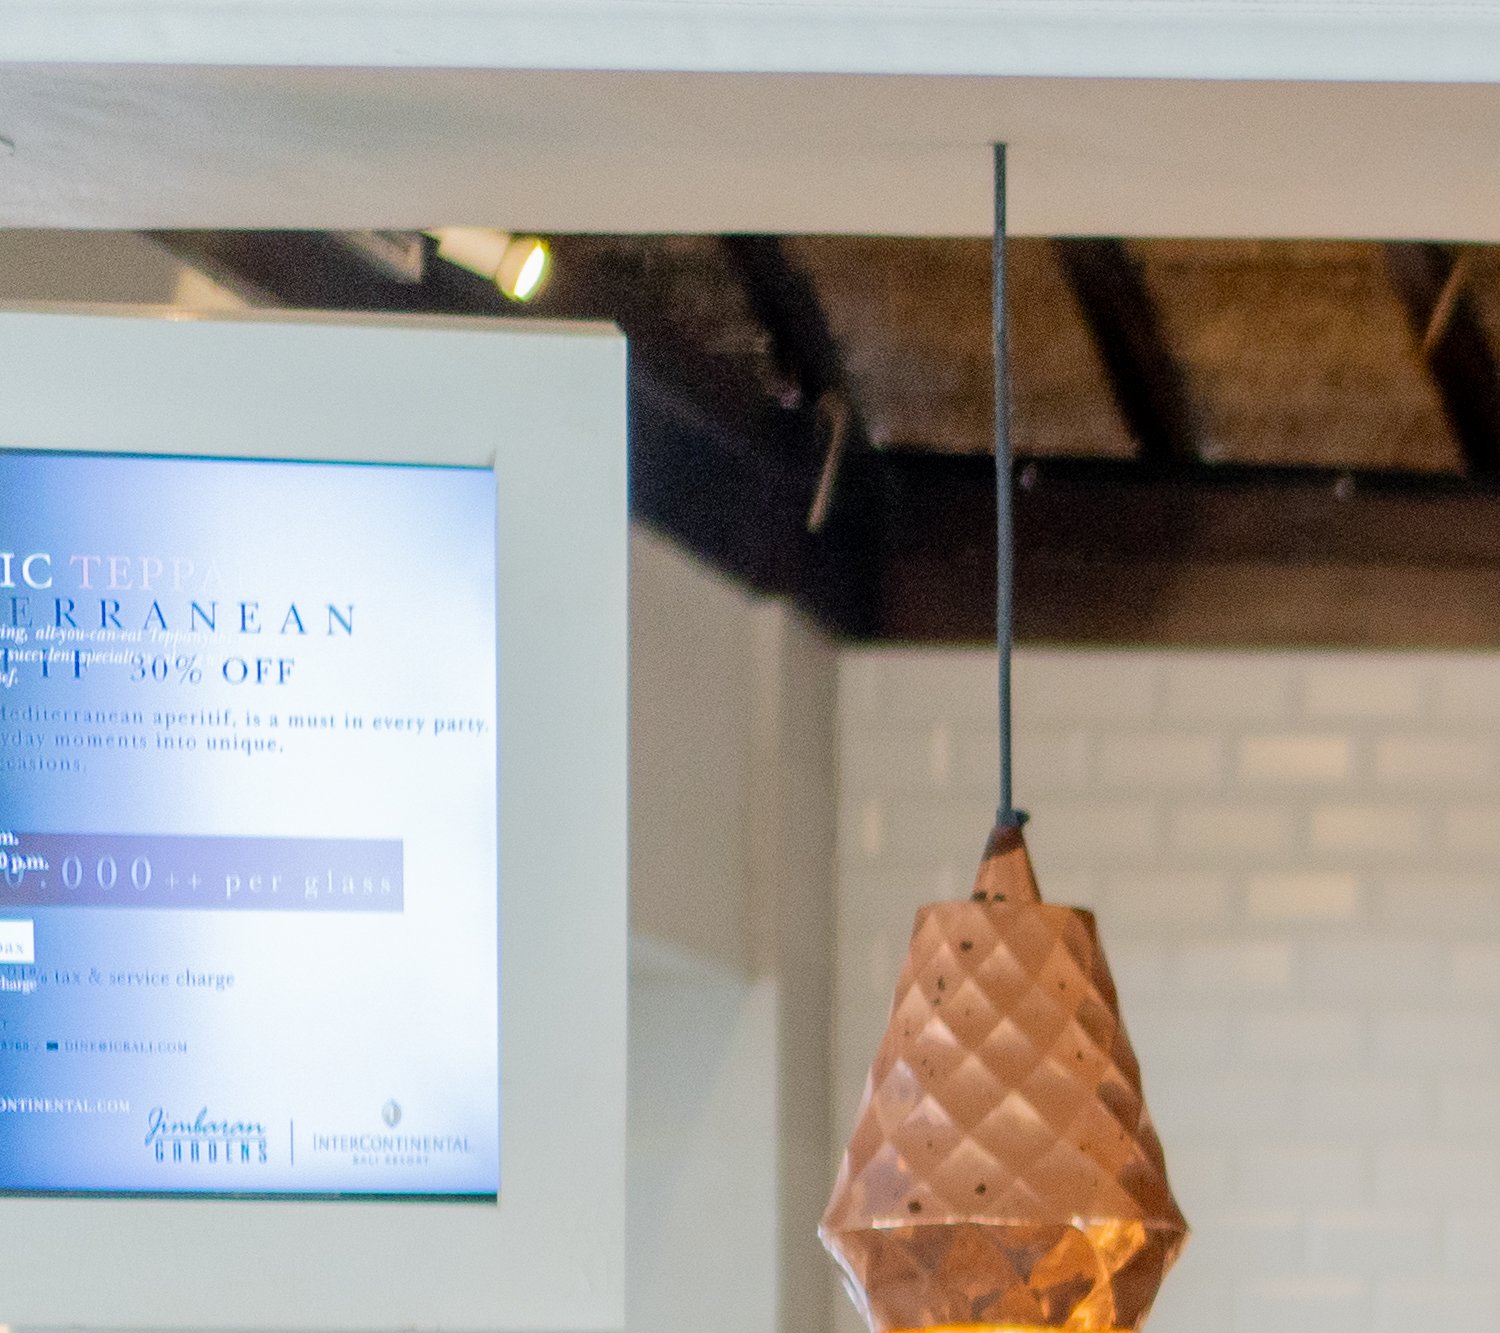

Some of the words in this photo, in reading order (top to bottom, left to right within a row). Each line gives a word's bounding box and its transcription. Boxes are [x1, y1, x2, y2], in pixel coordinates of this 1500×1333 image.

[222, 656, 295, 686] OFF
[245, 709, 261, 728] is
[269, 711, 279, 728] a
[288, 711, 336, 729] must
[344, 709, 363, 730] in
[372, 713, 425, 735] every
[55, 733, 148, 751] moments
[156, 734, 197, 752] into
[226, 873, 283, 899] per
[305, 868, 392, 900] glass
[109, 970, 169, 986] service
[176, 968, 236, 991] charge
